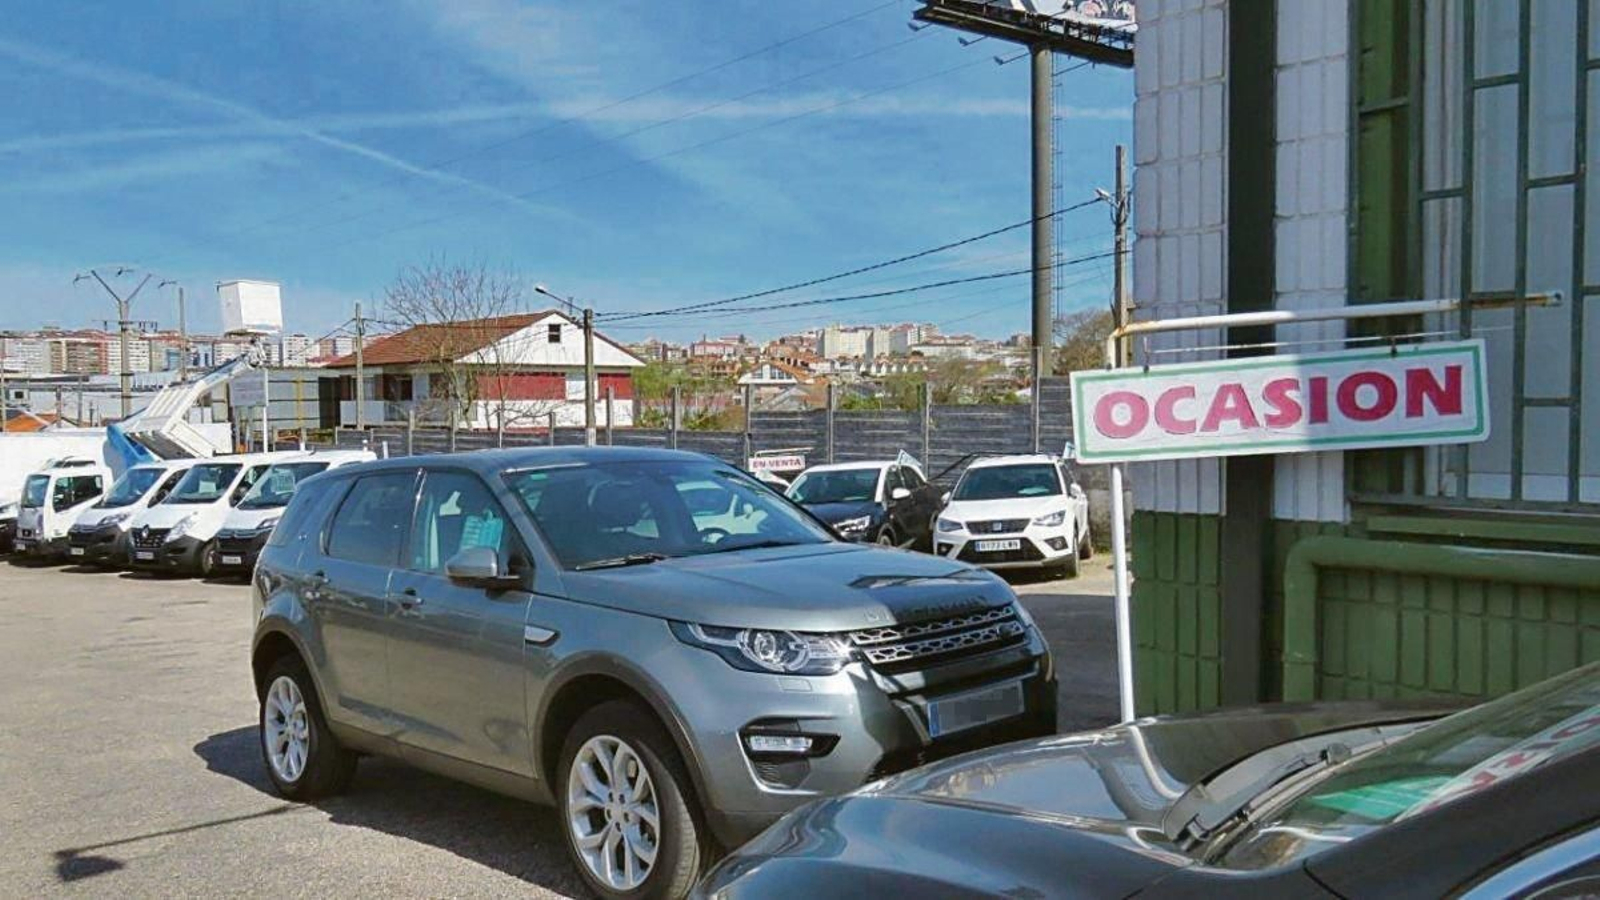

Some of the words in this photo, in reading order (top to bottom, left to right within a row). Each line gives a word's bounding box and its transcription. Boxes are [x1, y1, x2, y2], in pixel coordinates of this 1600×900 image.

[1093, 365, 1462, 439] OCASION
[753, 461, 766, 469] EN
[768, 458, 801, 467] VENTA
